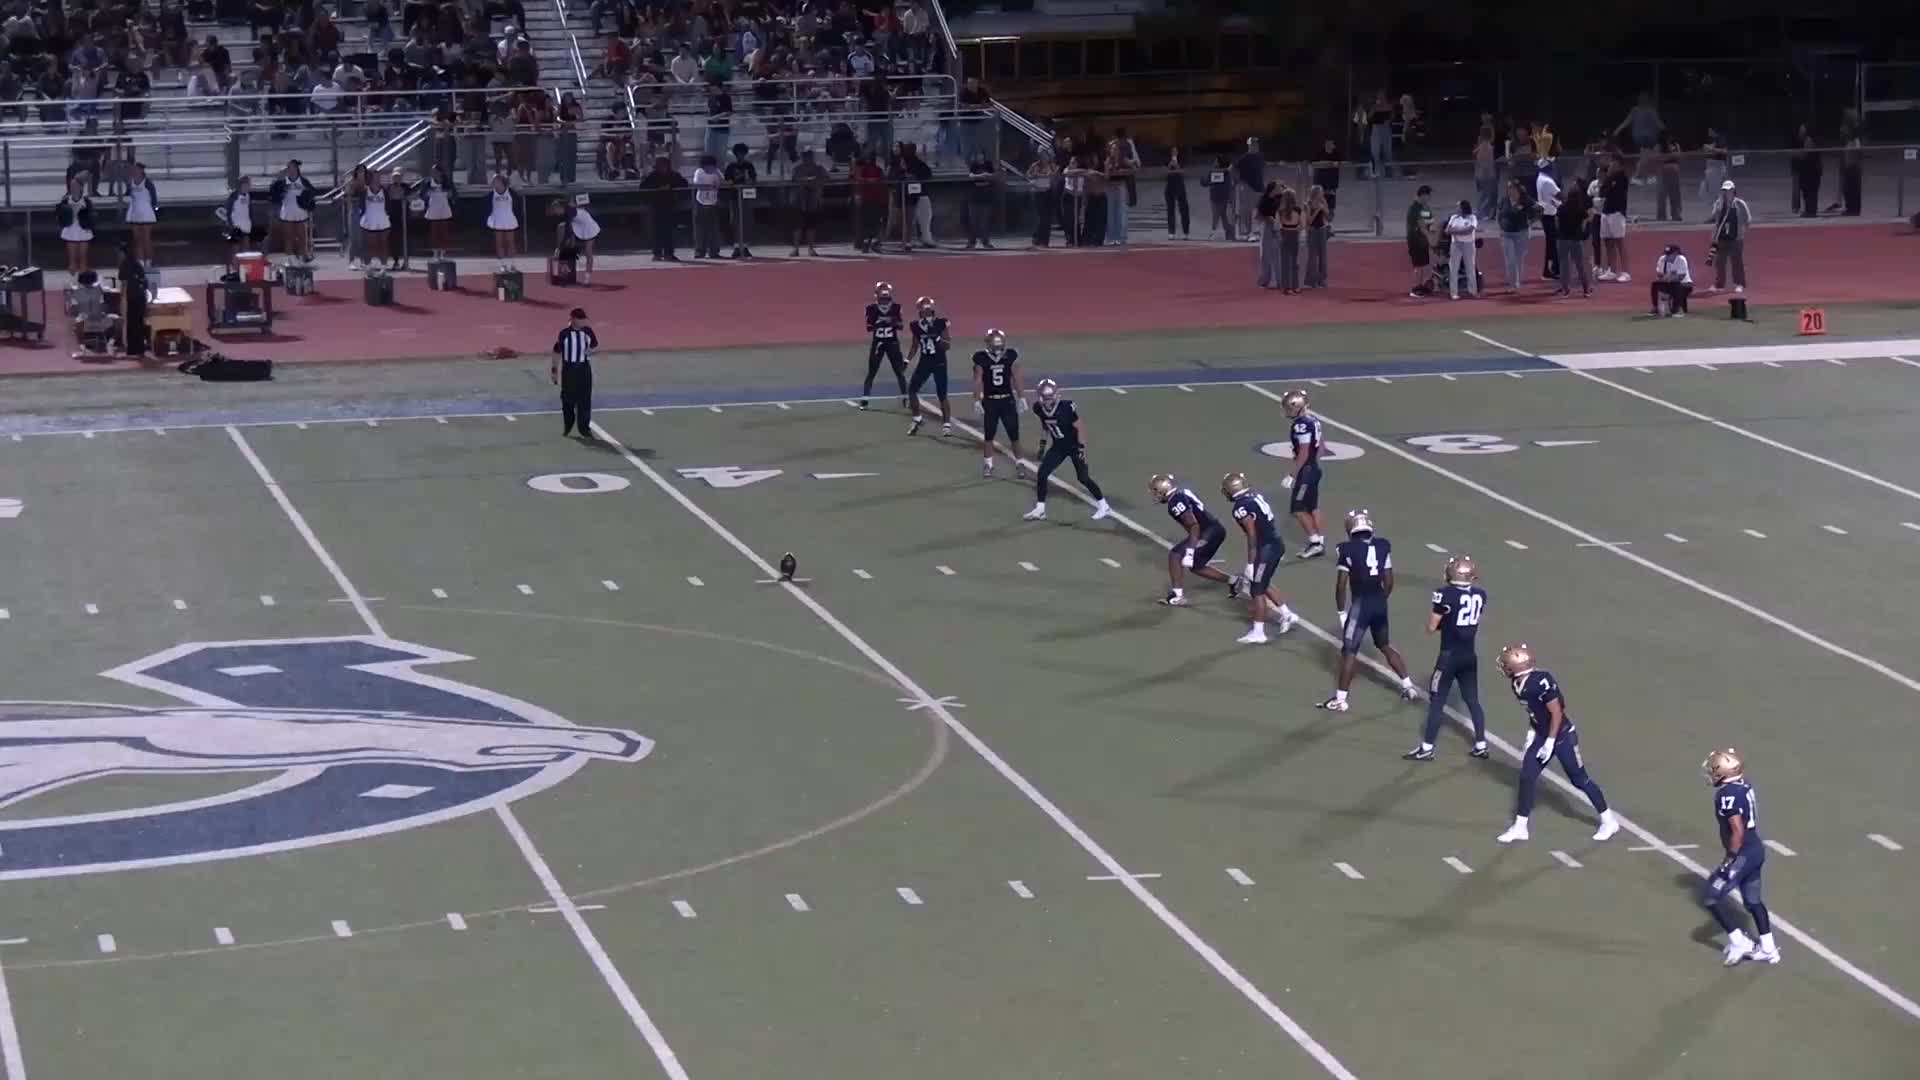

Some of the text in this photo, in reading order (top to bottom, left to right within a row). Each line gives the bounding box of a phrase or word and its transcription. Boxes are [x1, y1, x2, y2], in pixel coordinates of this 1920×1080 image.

[1803, 312, 1823, 331] 20
[920, 338, 936, 354] 14
[992, 368, 1004, 386] 5
[1171, 502, 1187, 517] 38
[1366, 545, 1379, 576] 4
[1456, 594, 1483, 626] 20
[1539, 678, 1550, 690] 7
[1721, 796, 1735, 810] 17
